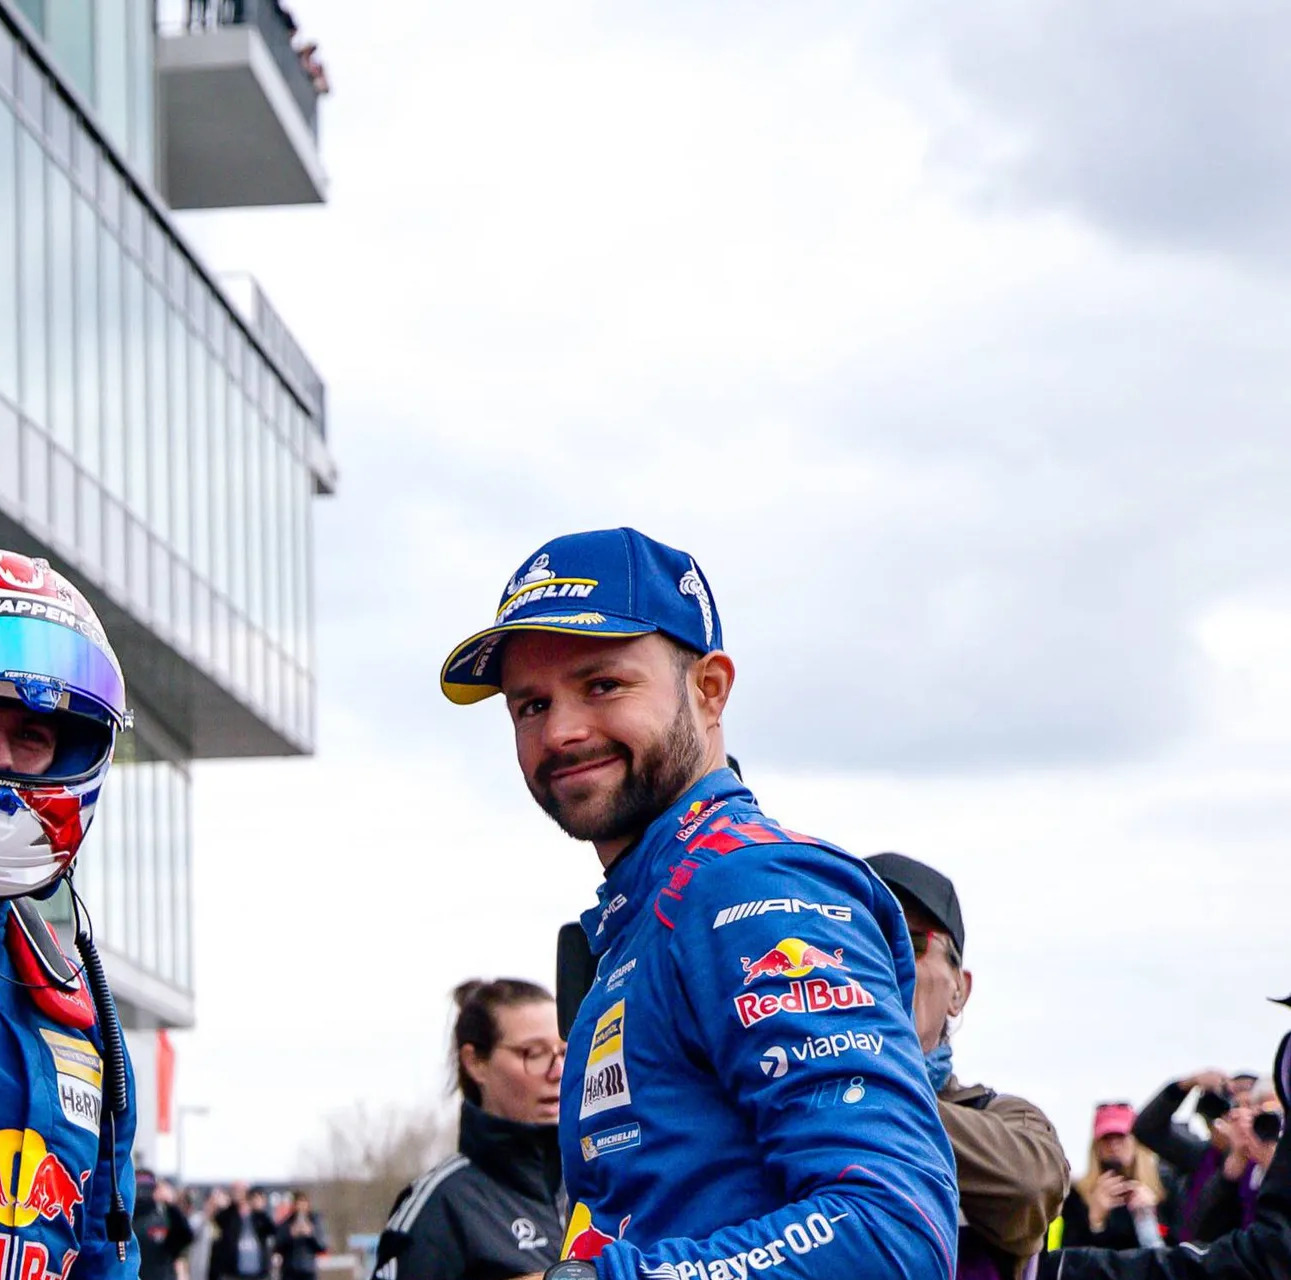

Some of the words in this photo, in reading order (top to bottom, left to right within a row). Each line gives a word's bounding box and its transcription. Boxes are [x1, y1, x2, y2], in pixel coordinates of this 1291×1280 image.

[751, 897, 852, 923] AMG
[734, 980, 807, 1029] Red
[791, 1030, 884, 1061] viaplay
[596, 1128, 639, 1148] MICHELIN
